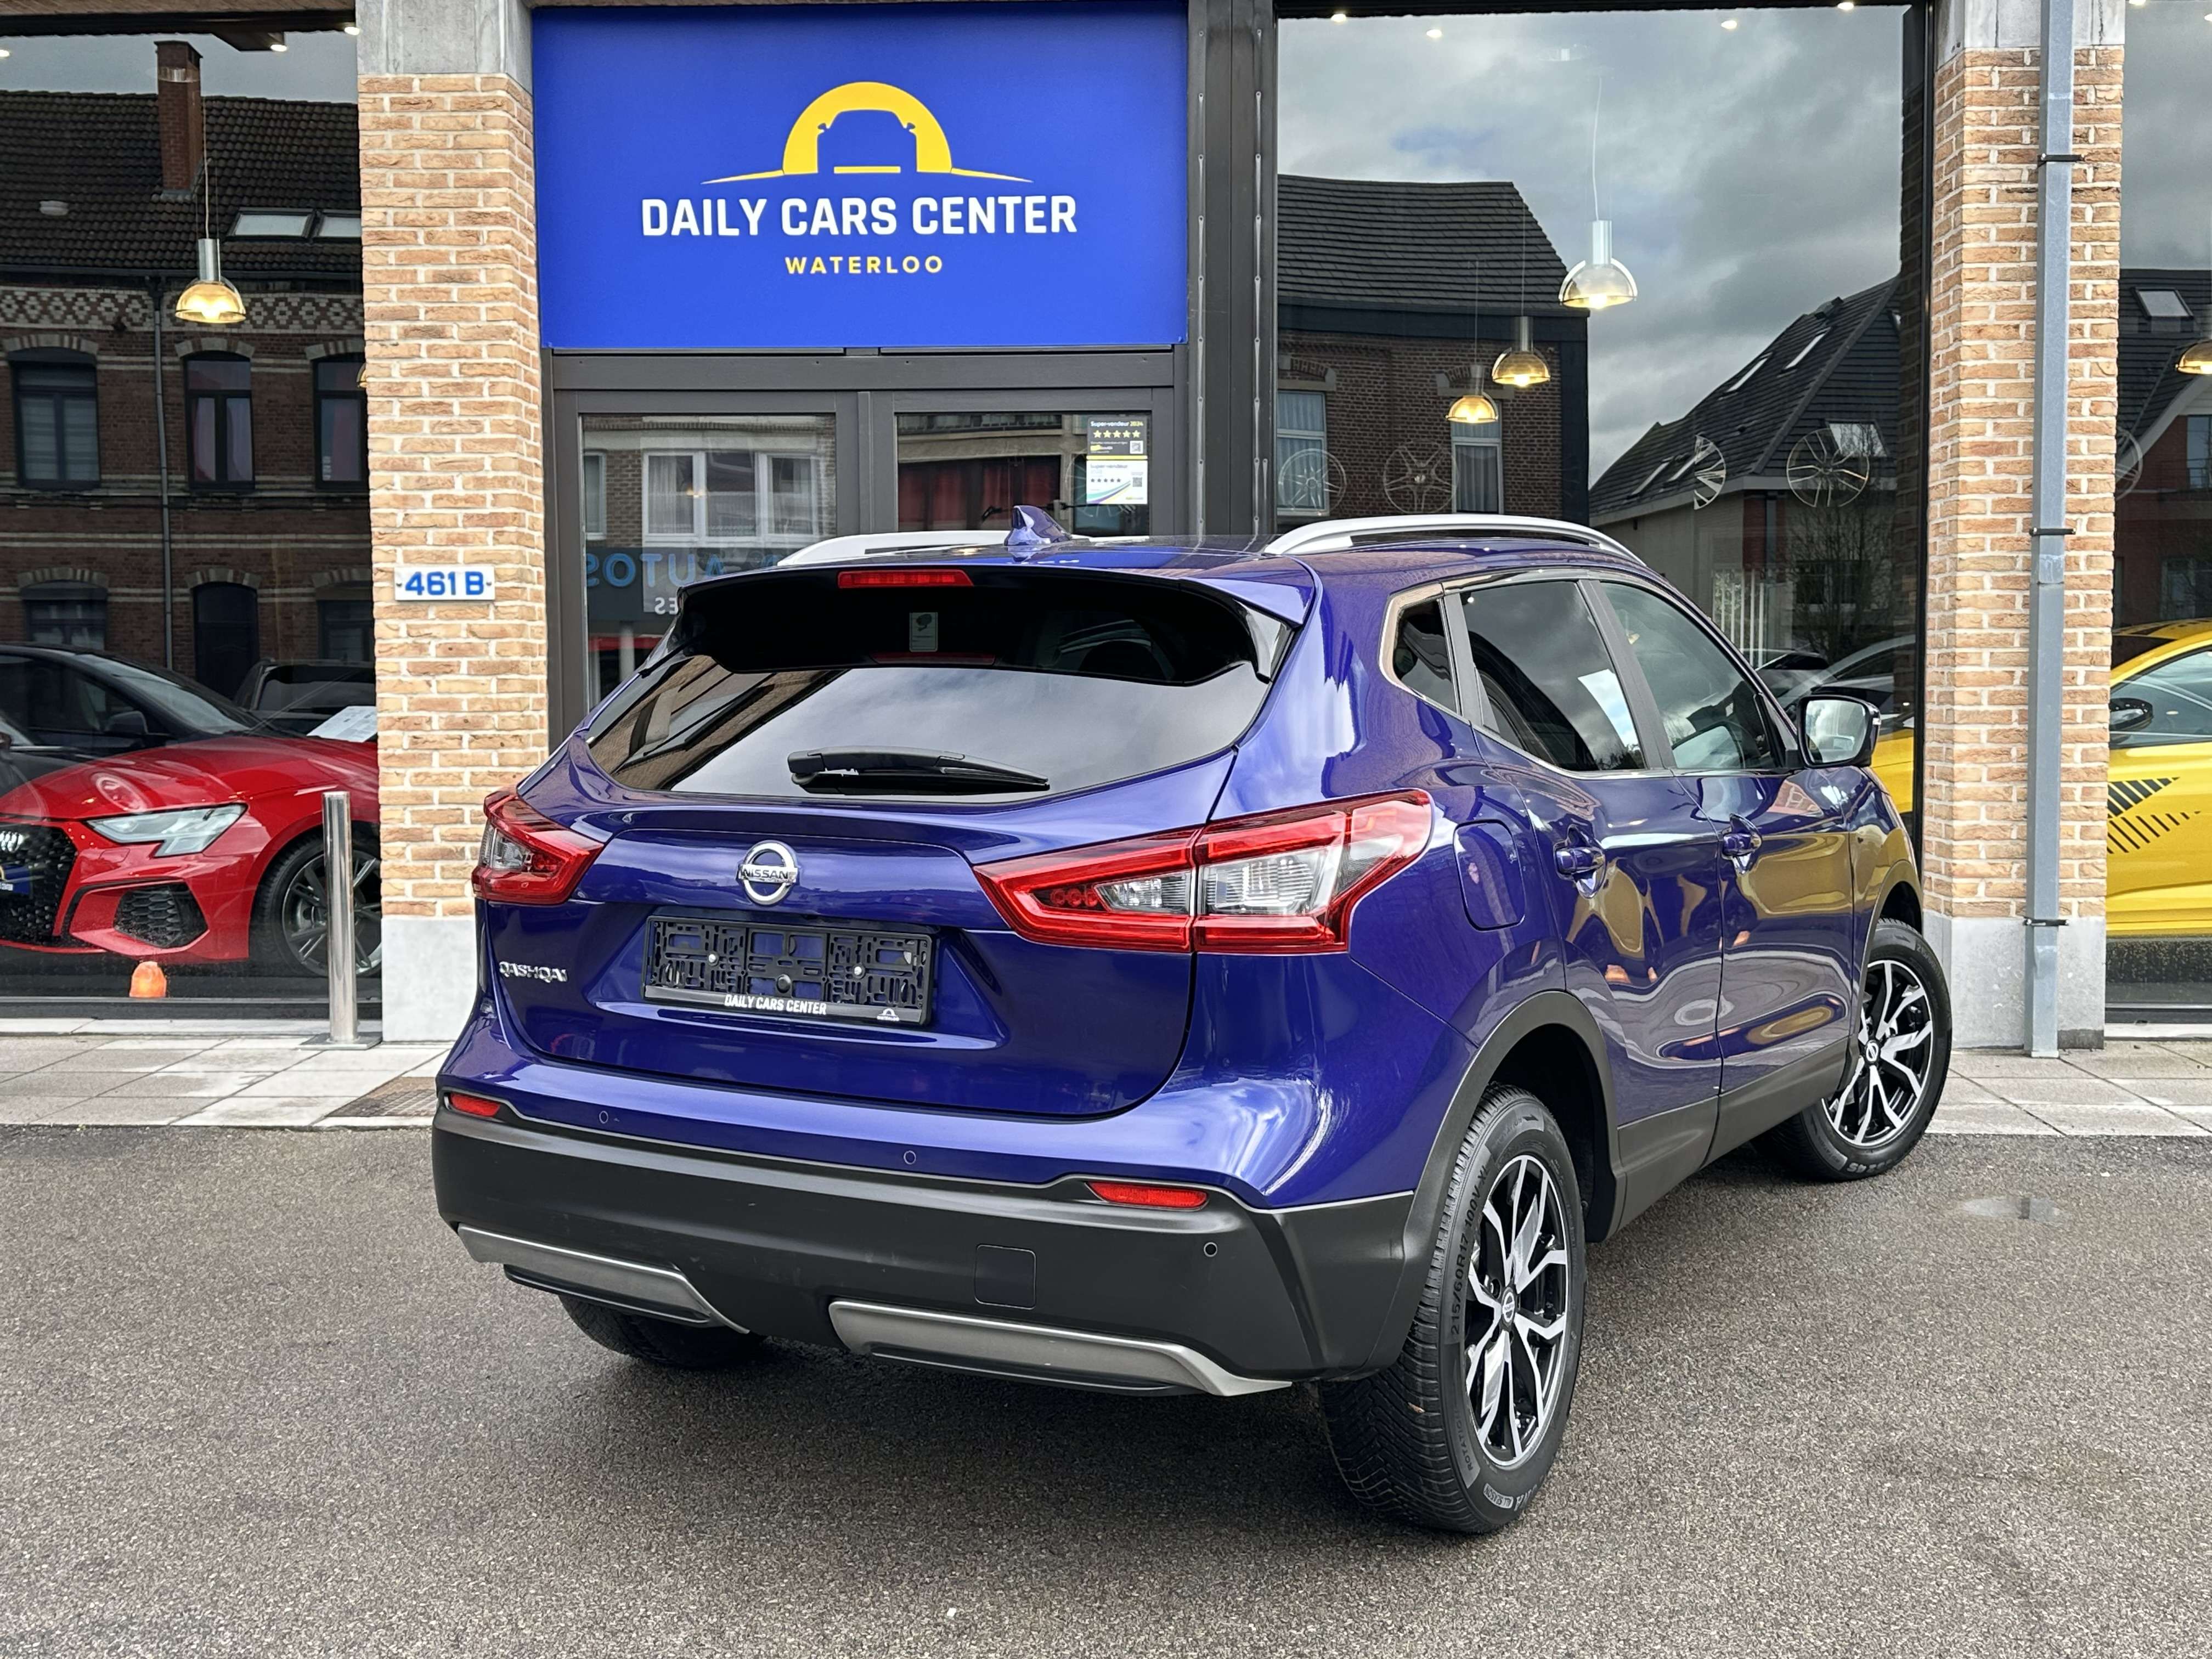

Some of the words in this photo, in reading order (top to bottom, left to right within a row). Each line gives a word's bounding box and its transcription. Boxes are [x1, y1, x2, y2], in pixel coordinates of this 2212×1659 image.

[642, 199, 767, 236] DAILY
[781, 197, 897, 236] CARS
[912, 195, 1077, 235] CENTER
[785, 256, 943, 274] WATERLOO
[405, 571, 456, 595] 461
[465, 571, 484, 595] B
[741, 868, 788, 880] NISSAN
[499, 961, 567, 983] QASHQAI
[724, 994, 755, 1008] DAILY
[755, 997, 785, 1012] CARS
[786, 1000, 827, 1015] CENTER
[1451, 1233, 1469, 1335] 215/60R17
